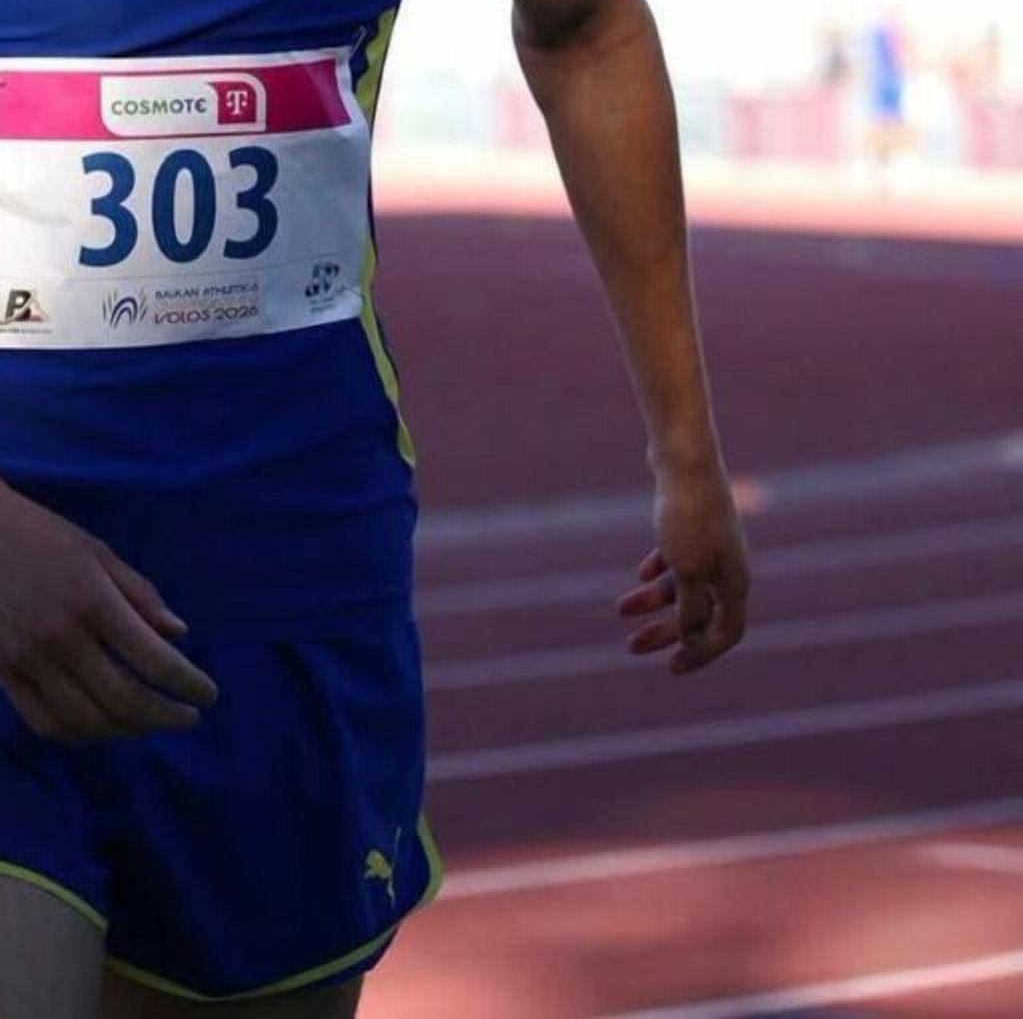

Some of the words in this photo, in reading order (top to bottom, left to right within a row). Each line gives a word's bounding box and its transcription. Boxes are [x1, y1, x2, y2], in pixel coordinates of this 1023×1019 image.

[111, 97, 208, 116] COSMOTE
[226, 90, 248, 115] T
[78, 145, 280, 268] 303
[154, 308, 210, 324] VOLOS
